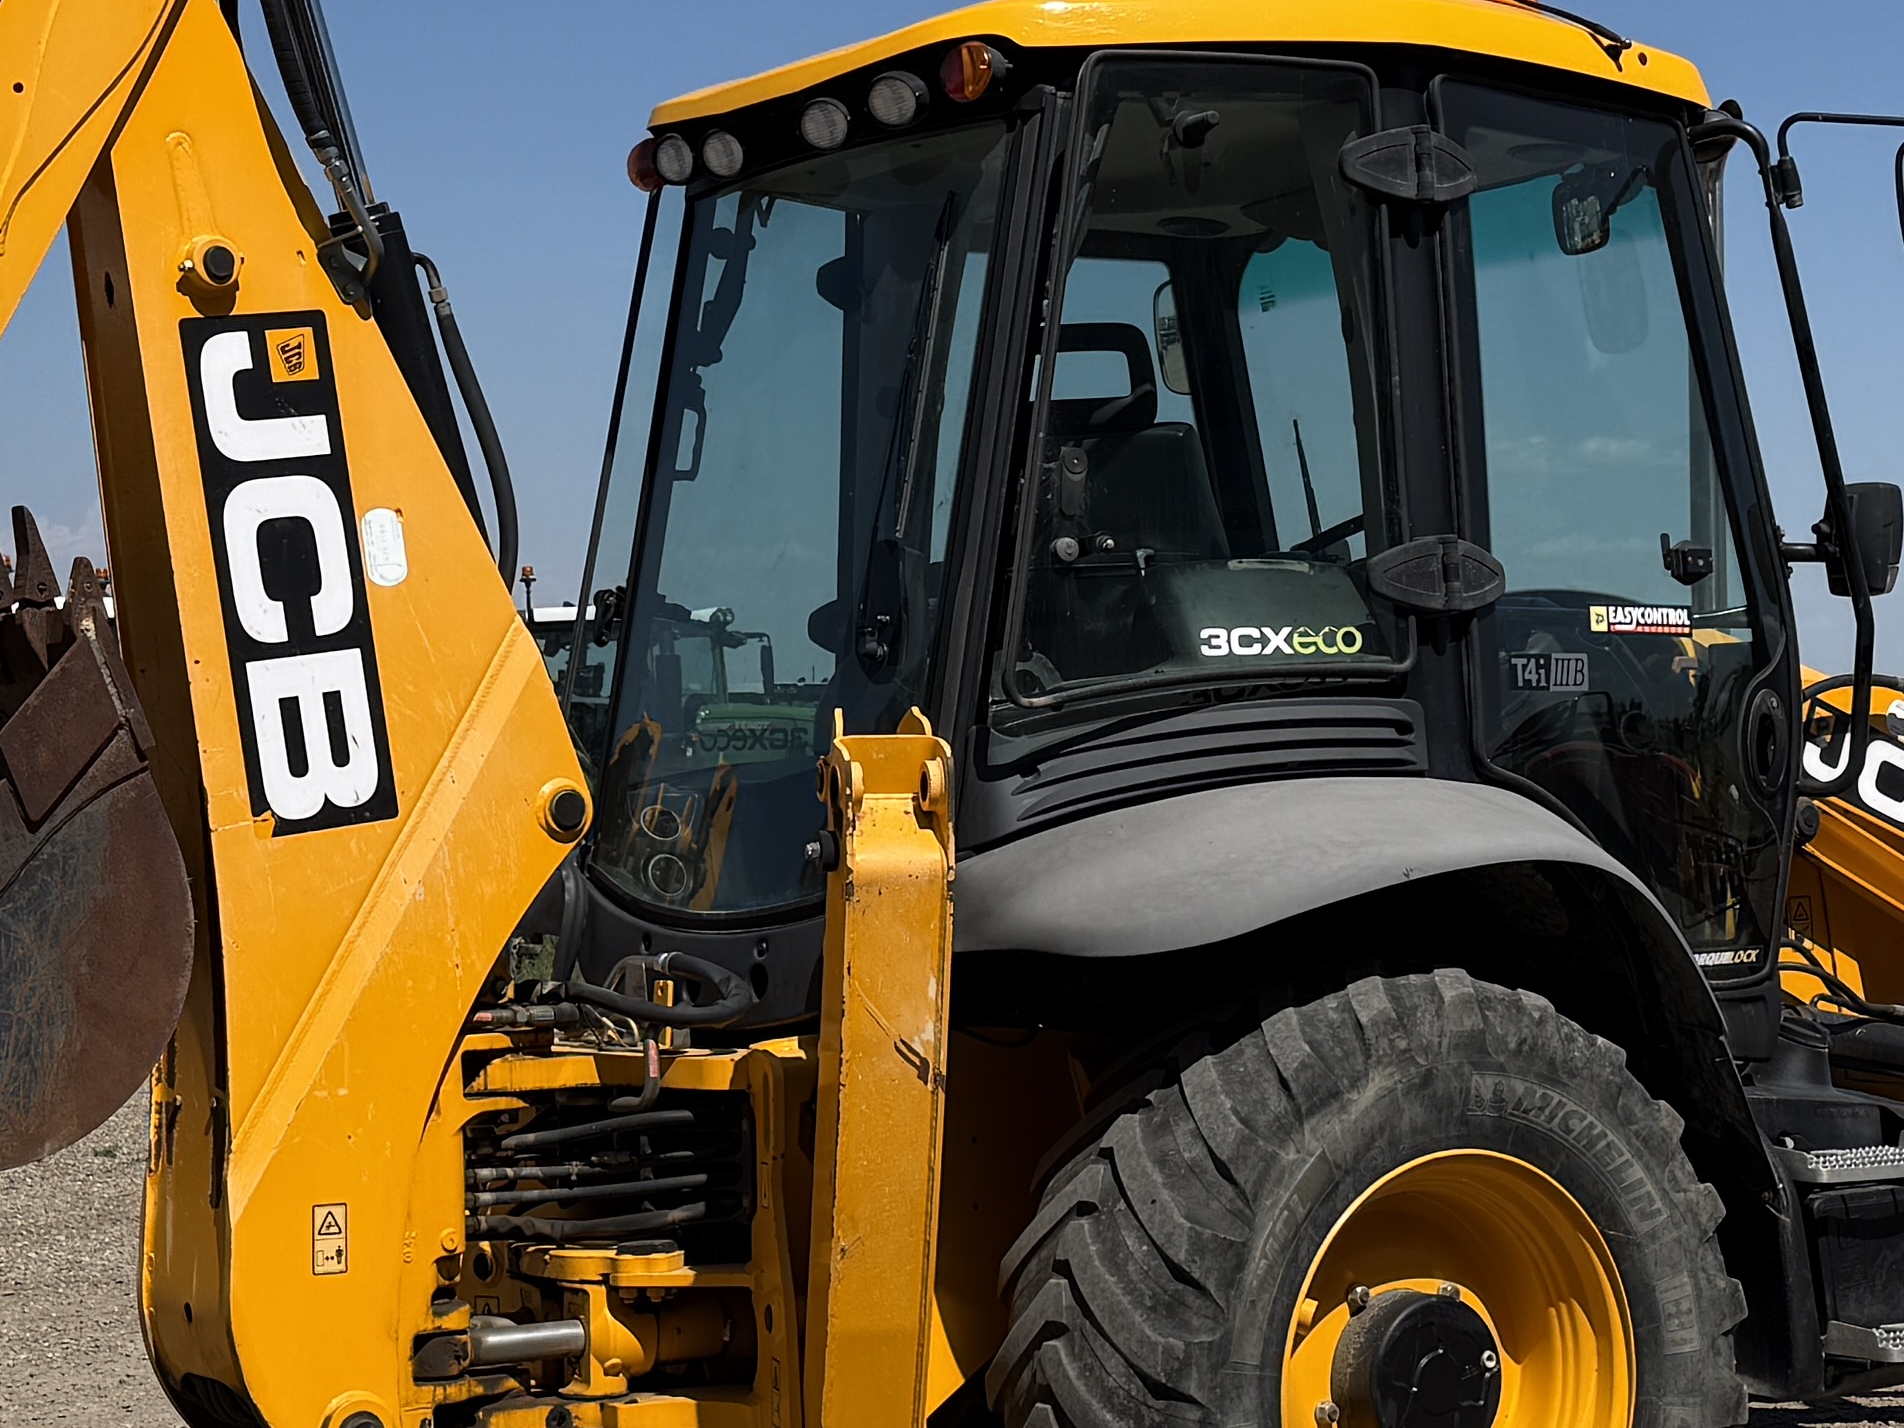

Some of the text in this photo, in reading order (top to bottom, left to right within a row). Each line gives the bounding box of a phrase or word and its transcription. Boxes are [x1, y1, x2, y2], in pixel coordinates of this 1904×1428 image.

[279, 340, 303, 373] JCB
[199, 330, 379, 820] JCB
[1607, 605, 1691, 630] EASYCONTROL
[1199, 625, 1363, 657] 3CXeco
[1510, 657, 1549, 687] T4i
[1510, 1083, 1664, 1225] MICHELIN
